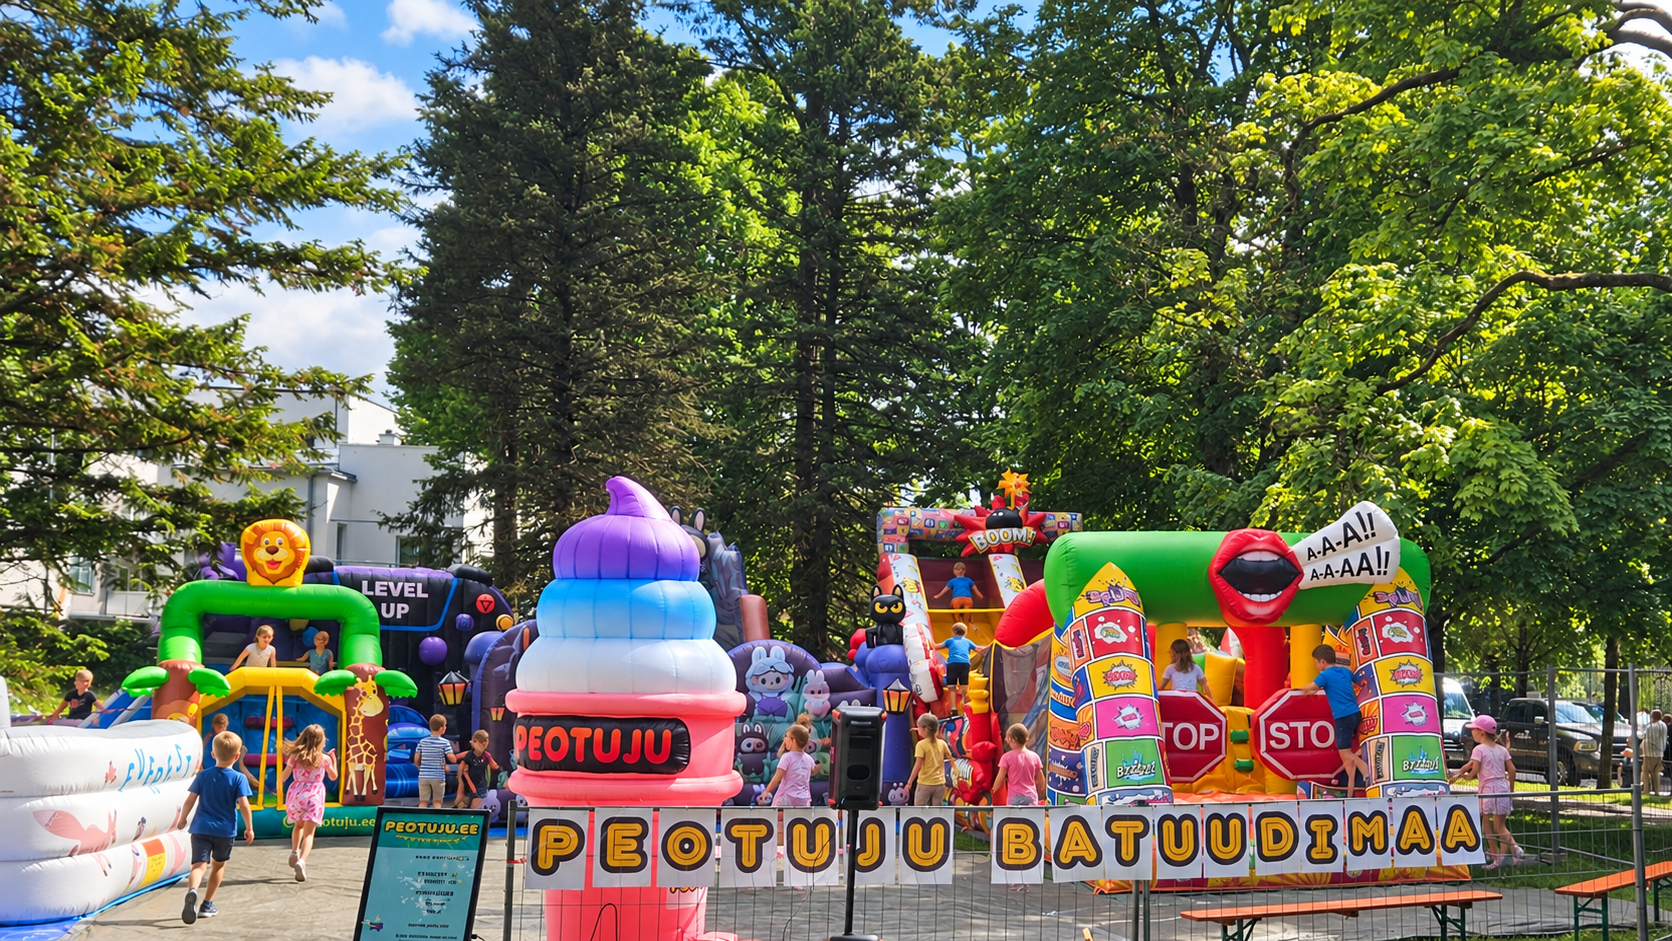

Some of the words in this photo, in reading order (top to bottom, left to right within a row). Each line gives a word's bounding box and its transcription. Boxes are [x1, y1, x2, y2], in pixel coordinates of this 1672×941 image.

[1307, 511, 1377, 561] A-A-A!!
[1310, 546, 1391, 581] A-A-AA!!
[361, 580, 429, 599] LEVEL
[380, 602, 410, 619] UP
[515, 724, 673, 765] PEOTUJU
[1161, 721, 1220, 751] TOP
[1269, 720, 1335, 750] STO
[384, 820, 480, 836] PEOTUJU.EE
[531, 814, 950, 877] PEOTUJU
[996, 803, 1481, 869] BATUUDIMAA
